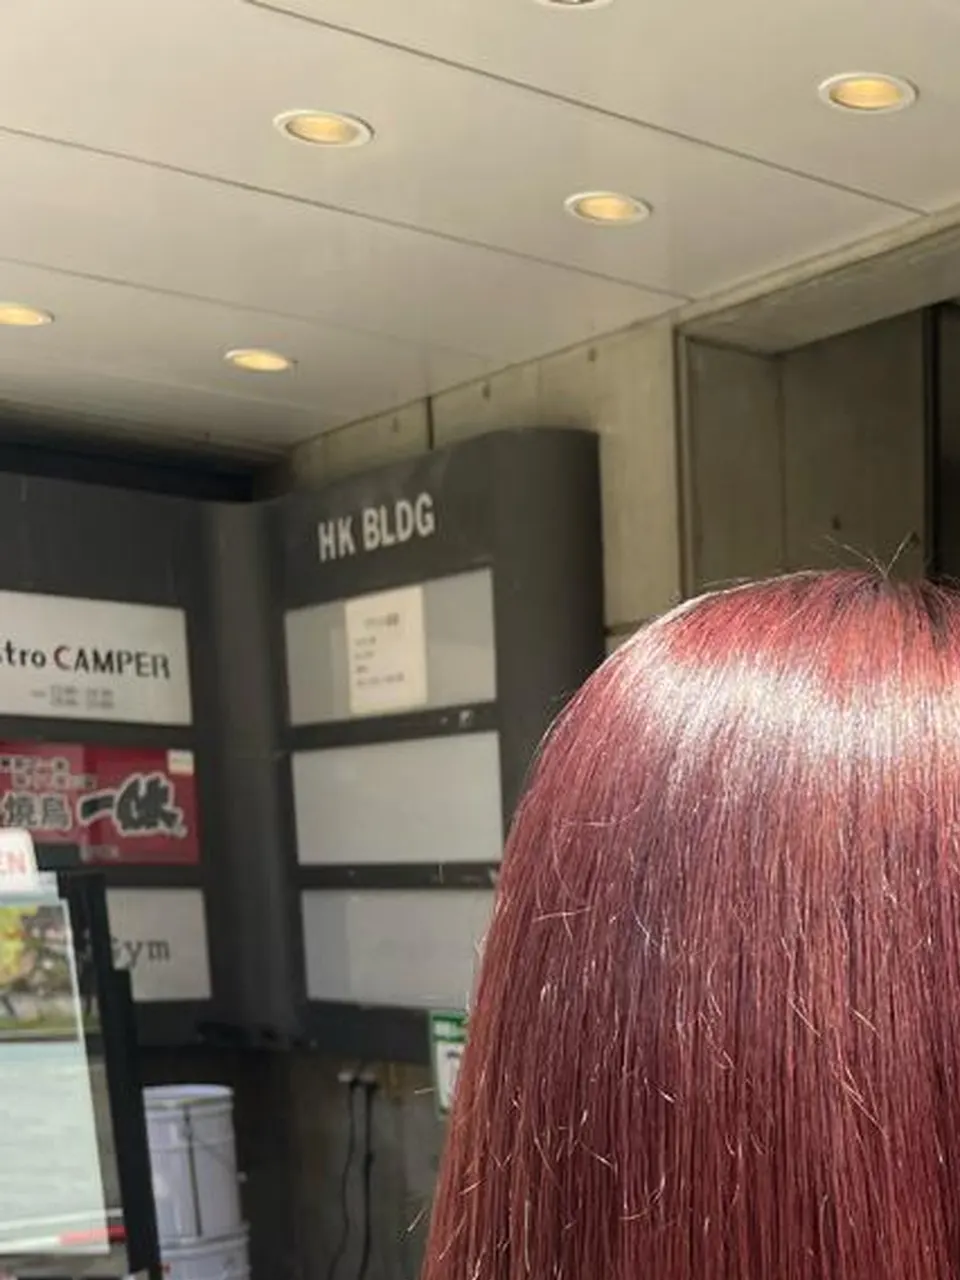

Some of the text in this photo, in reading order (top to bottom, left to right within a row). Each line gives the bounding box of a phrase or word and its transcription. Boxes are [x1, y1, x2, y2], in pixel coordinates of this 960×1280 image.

[318, 491, 435, 563] HK BLDG
[0, 639, 171, 680] tro CAMPER
